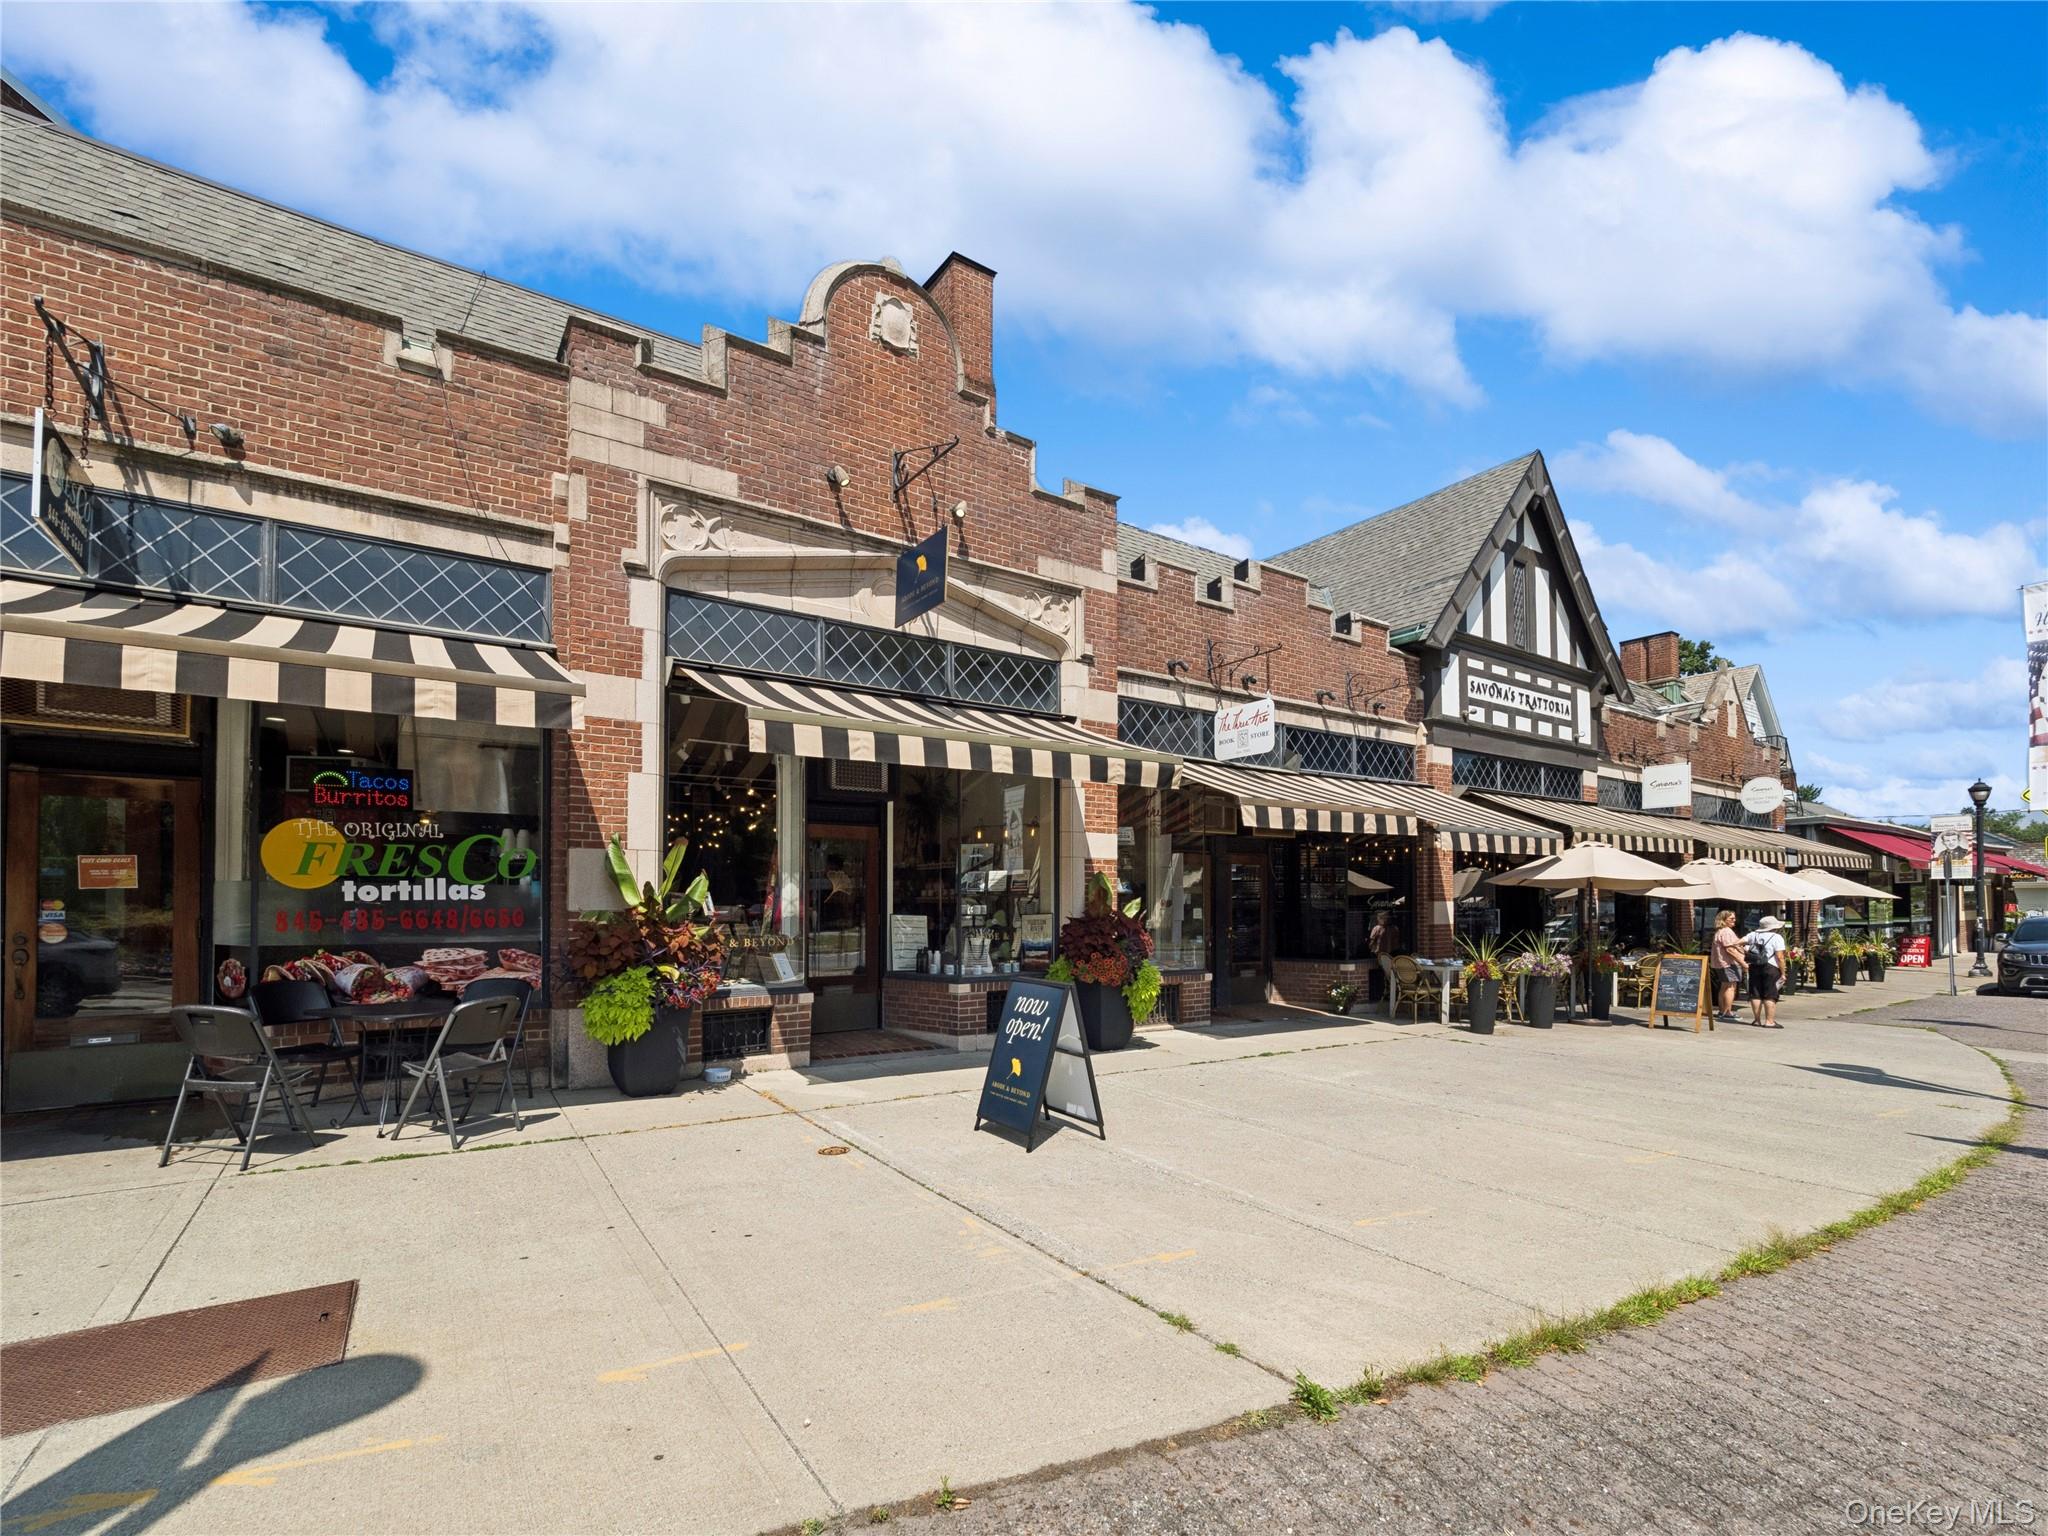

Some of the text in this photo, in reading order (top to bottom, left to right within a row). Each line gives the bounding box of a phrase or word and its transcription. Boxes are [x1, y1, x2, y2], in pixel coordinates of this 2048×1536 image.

[1470, 681, 1570, 716] SAVONA'S TRATTORIA
[1218, 708, 1270, 734] The Three Arts
[1218, 730, 1269, 746] BOOK STORE
[346, 770, 409, 790] Tacos
[313, 783, 408, 807] Burritos
[292, 818, 444, 840] THE ORIGINAL
[341, 877, 486, 901] tortillas
[729, 937, 795, 947] & BEYOND
[1901, 954, 1925, 963] OPEN
[1014, 995, 1049, 1016] now
[1006, 1017, 1050, 1044] open!
